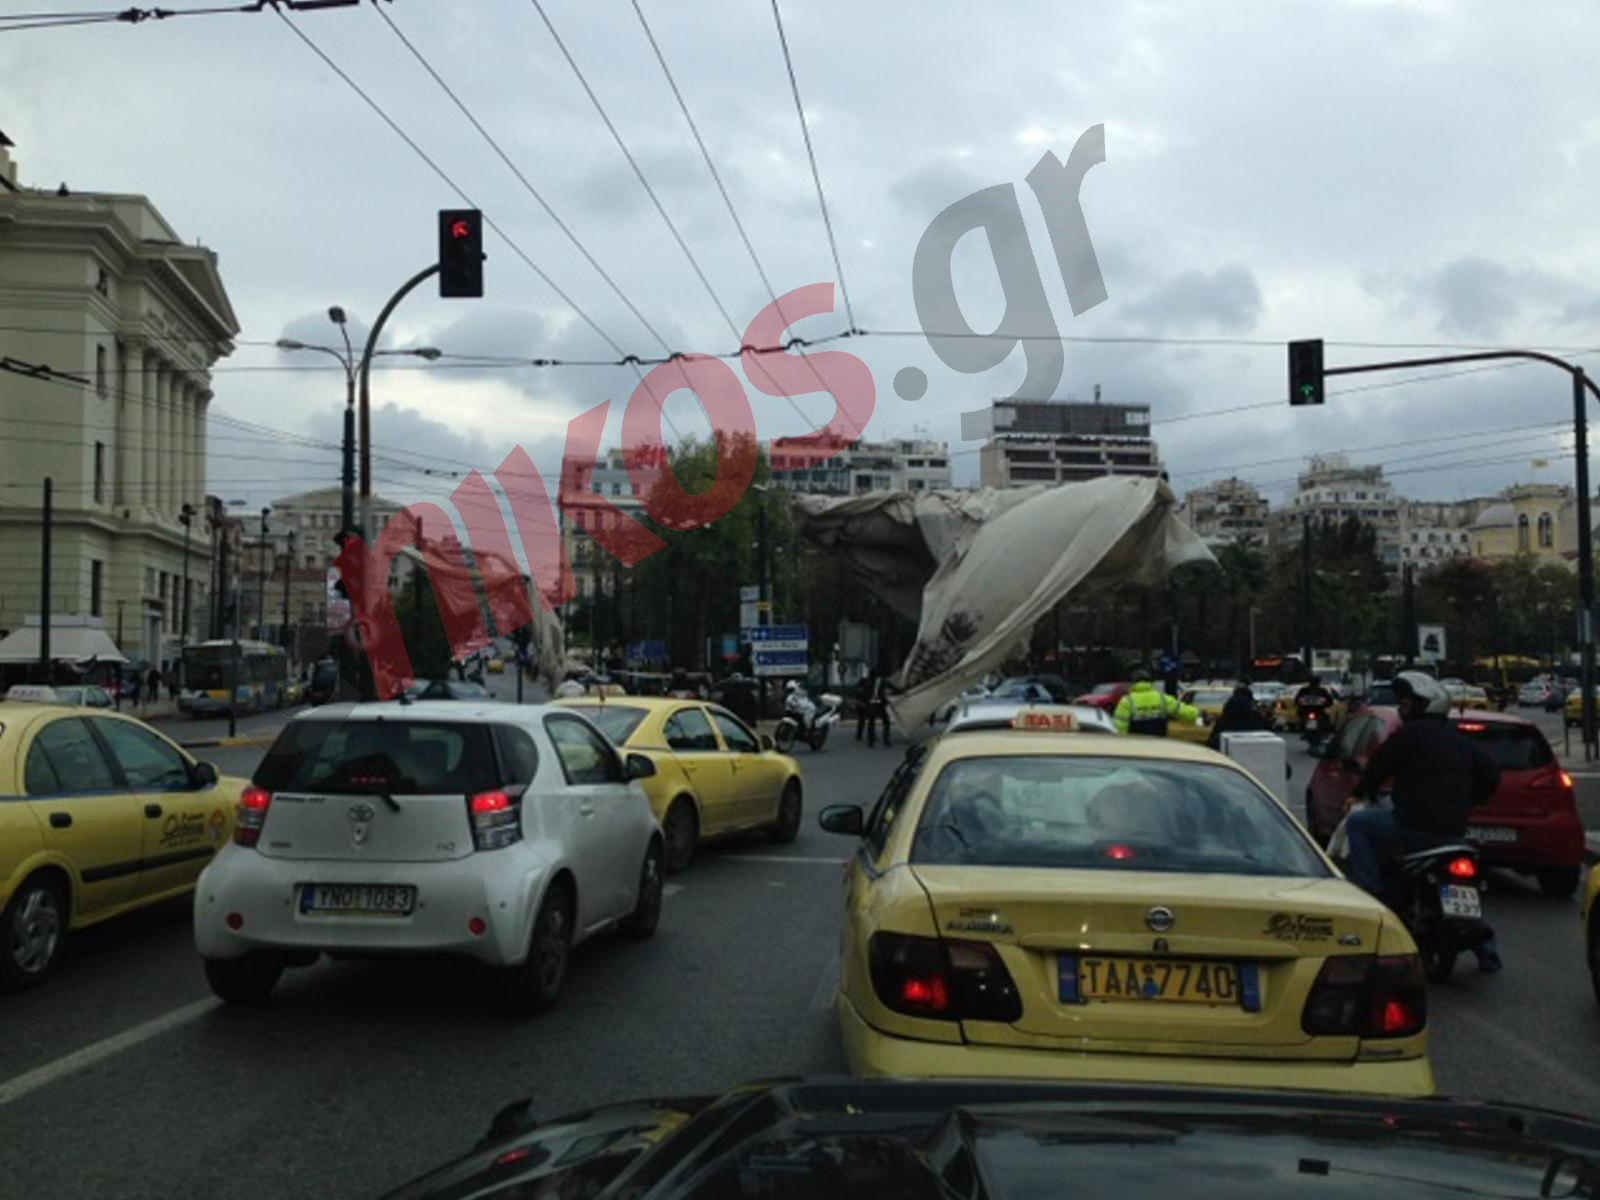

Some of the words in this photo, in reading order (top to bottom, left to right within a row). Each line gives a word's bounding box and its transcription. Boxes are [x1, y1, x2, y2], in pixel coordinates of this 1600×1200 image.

[1023, 713, 1073, 731] TAXI
[1085, 960, 1142, 996] TAA
[1155, 963, 1233, 999] 7740
